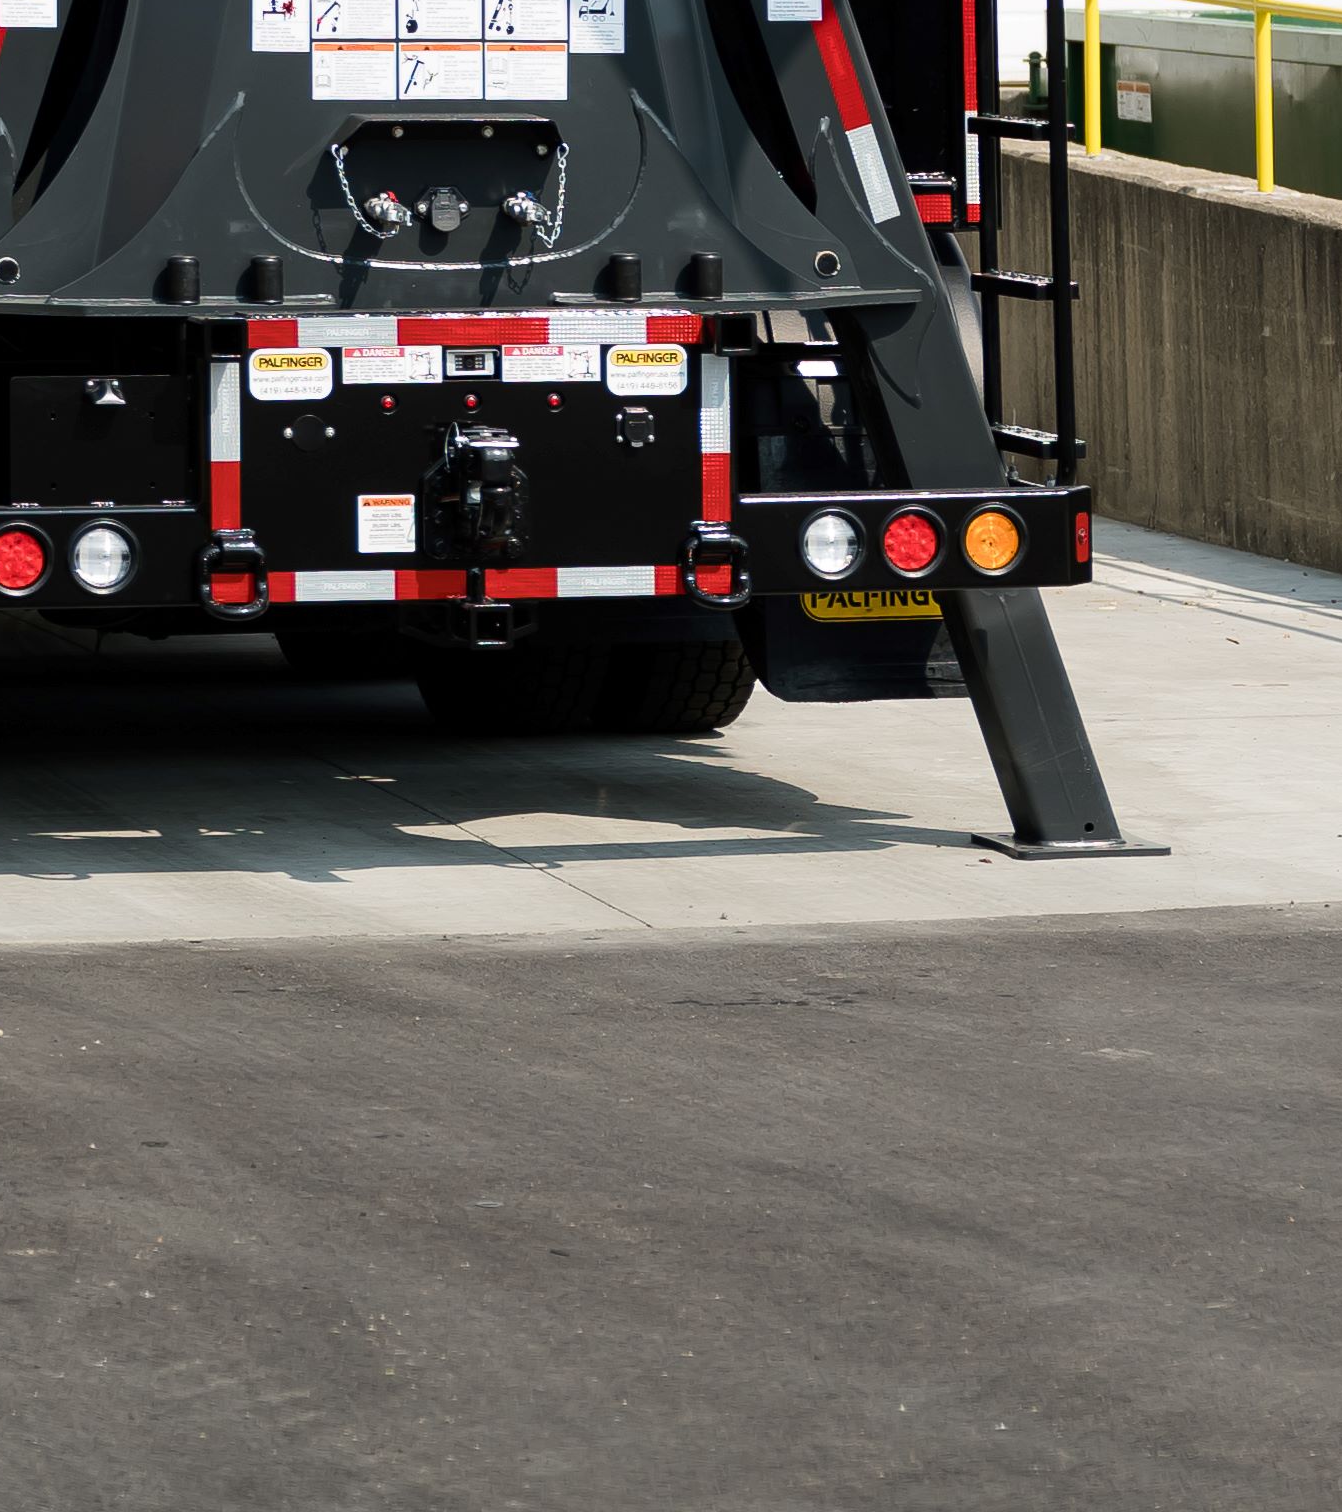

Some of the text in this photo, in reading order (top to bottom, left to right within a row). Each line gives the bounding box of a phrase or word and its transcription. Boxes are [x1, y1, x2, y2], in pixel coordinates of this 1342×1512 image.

[362, 348, 401, 357] DANGER
[521, 346, 560, 355] DANGER
[258, 356, 323, 369] PALFINGER
[616, 352, 679, 364] PALFINGER
